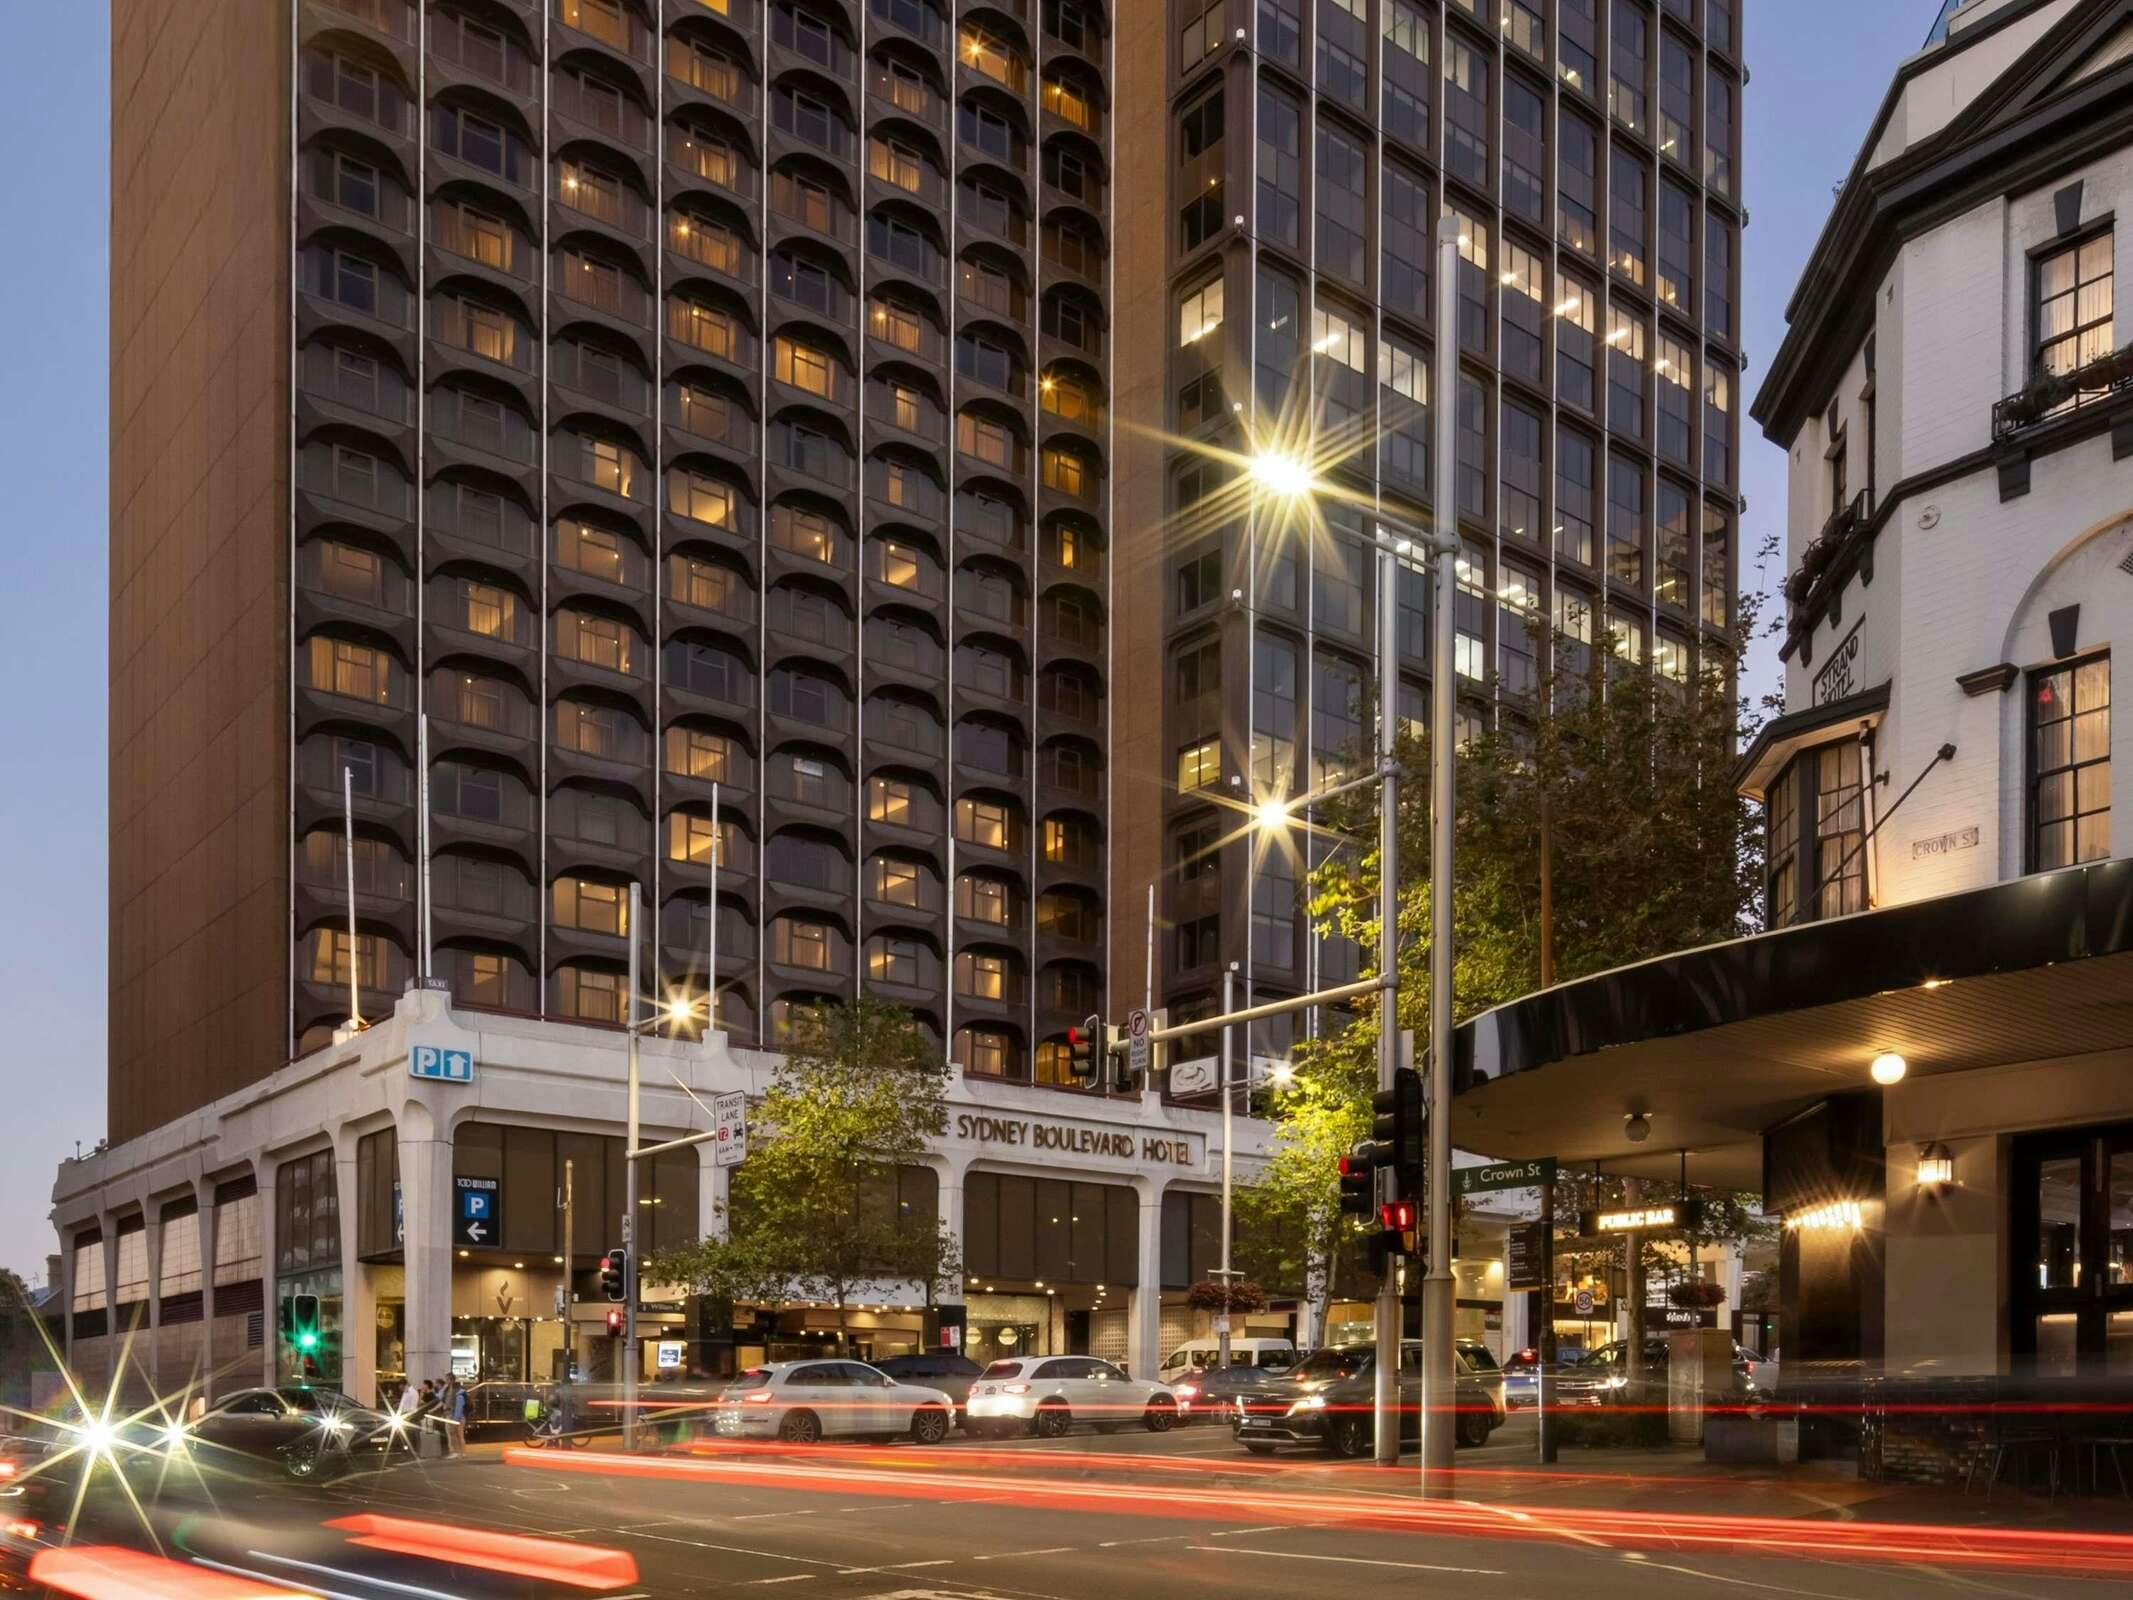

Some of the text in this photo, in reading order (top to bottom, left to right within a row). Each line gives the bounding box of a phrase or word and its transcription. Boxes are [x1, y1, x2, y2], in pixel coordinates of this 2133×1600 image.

[1821, 635, 1858, 698] STRAND
[1916, 833, 1957, 857] CROWN
[1134, 1038, 1144, 1048] NO
[417, 1048, 436, 1074] P
[717, 1096, 742, 1110] TRANSIT
[721, 1110, 738, 1121] LANE
[957, 1114, 1029, 1144] SYDNEY
[1033, 1124, 1134, 1158] BOULEVARD
[1143, 1138, 1193, 1166] HOTEL
[1480, 1163, 1541, 1182] Crown St
[471, 1197, 484, 1214] P
[1598, 1209, 1674, 1231] PUBLIC BAR
